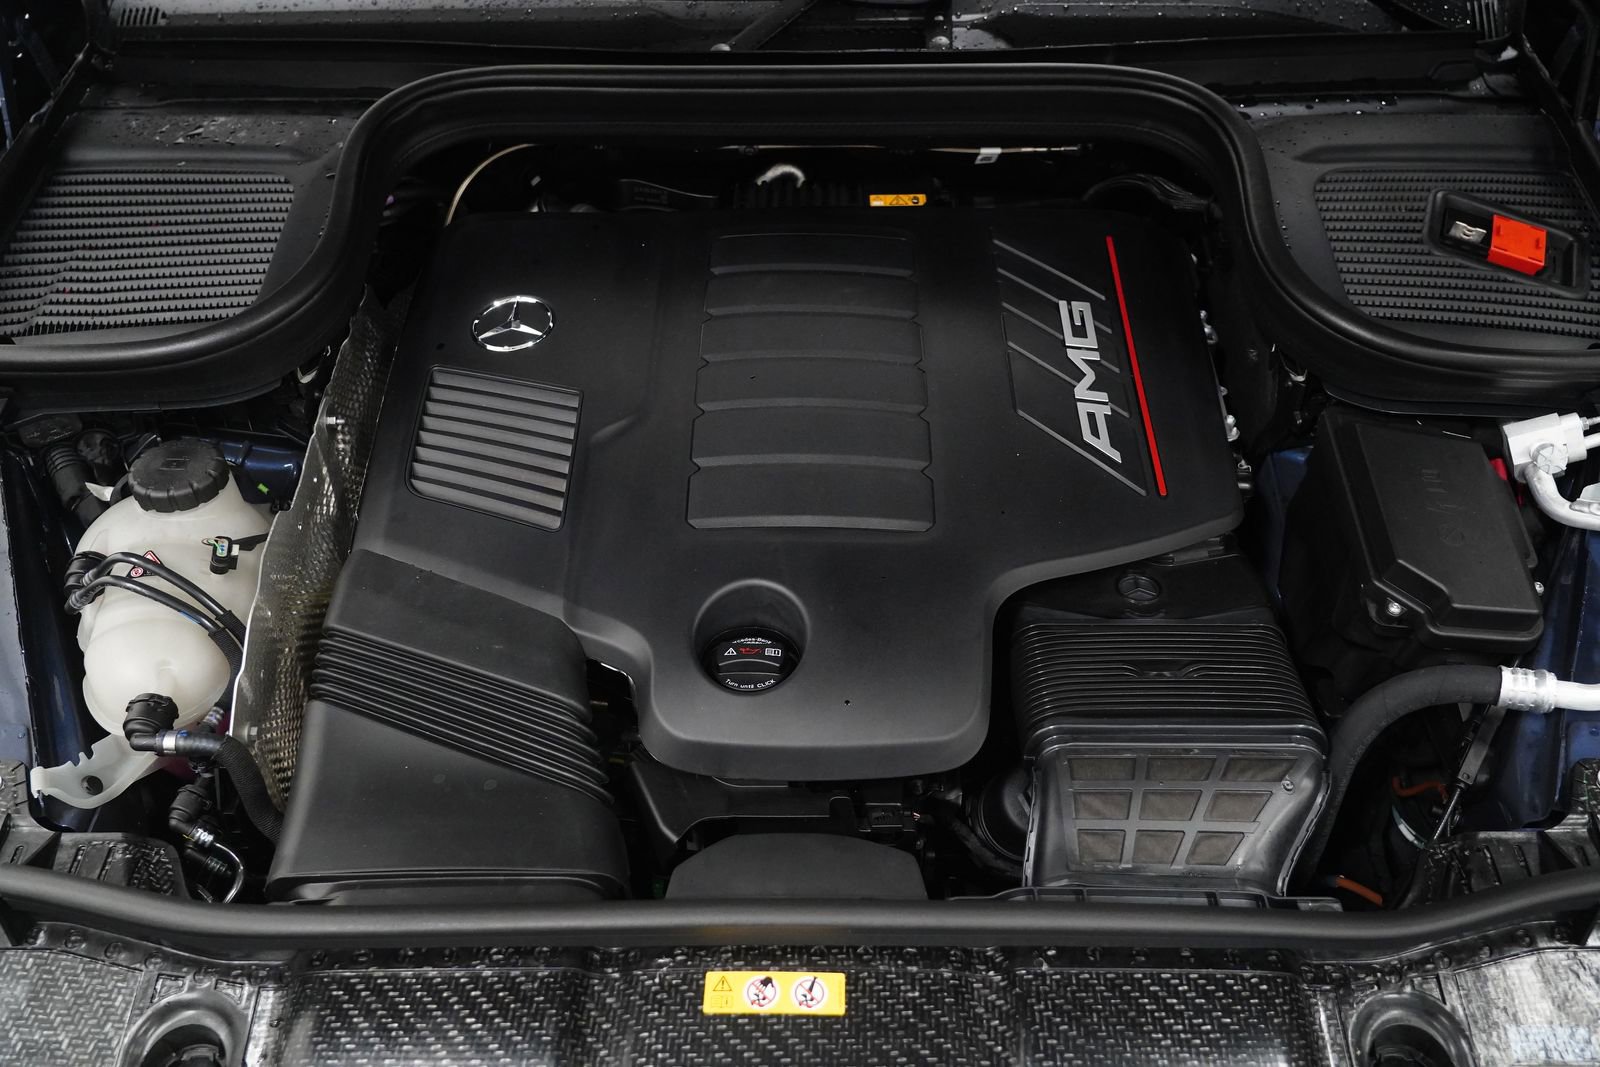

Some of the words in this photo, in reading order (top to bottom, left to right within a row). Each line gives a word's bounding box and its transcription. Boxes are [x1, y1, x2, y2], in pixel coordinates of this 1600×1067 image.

[1058, 300, 1122, 463] AMG
[725, 678, 739, 687] Turn
[756, 678, 776, 688] CLICK
